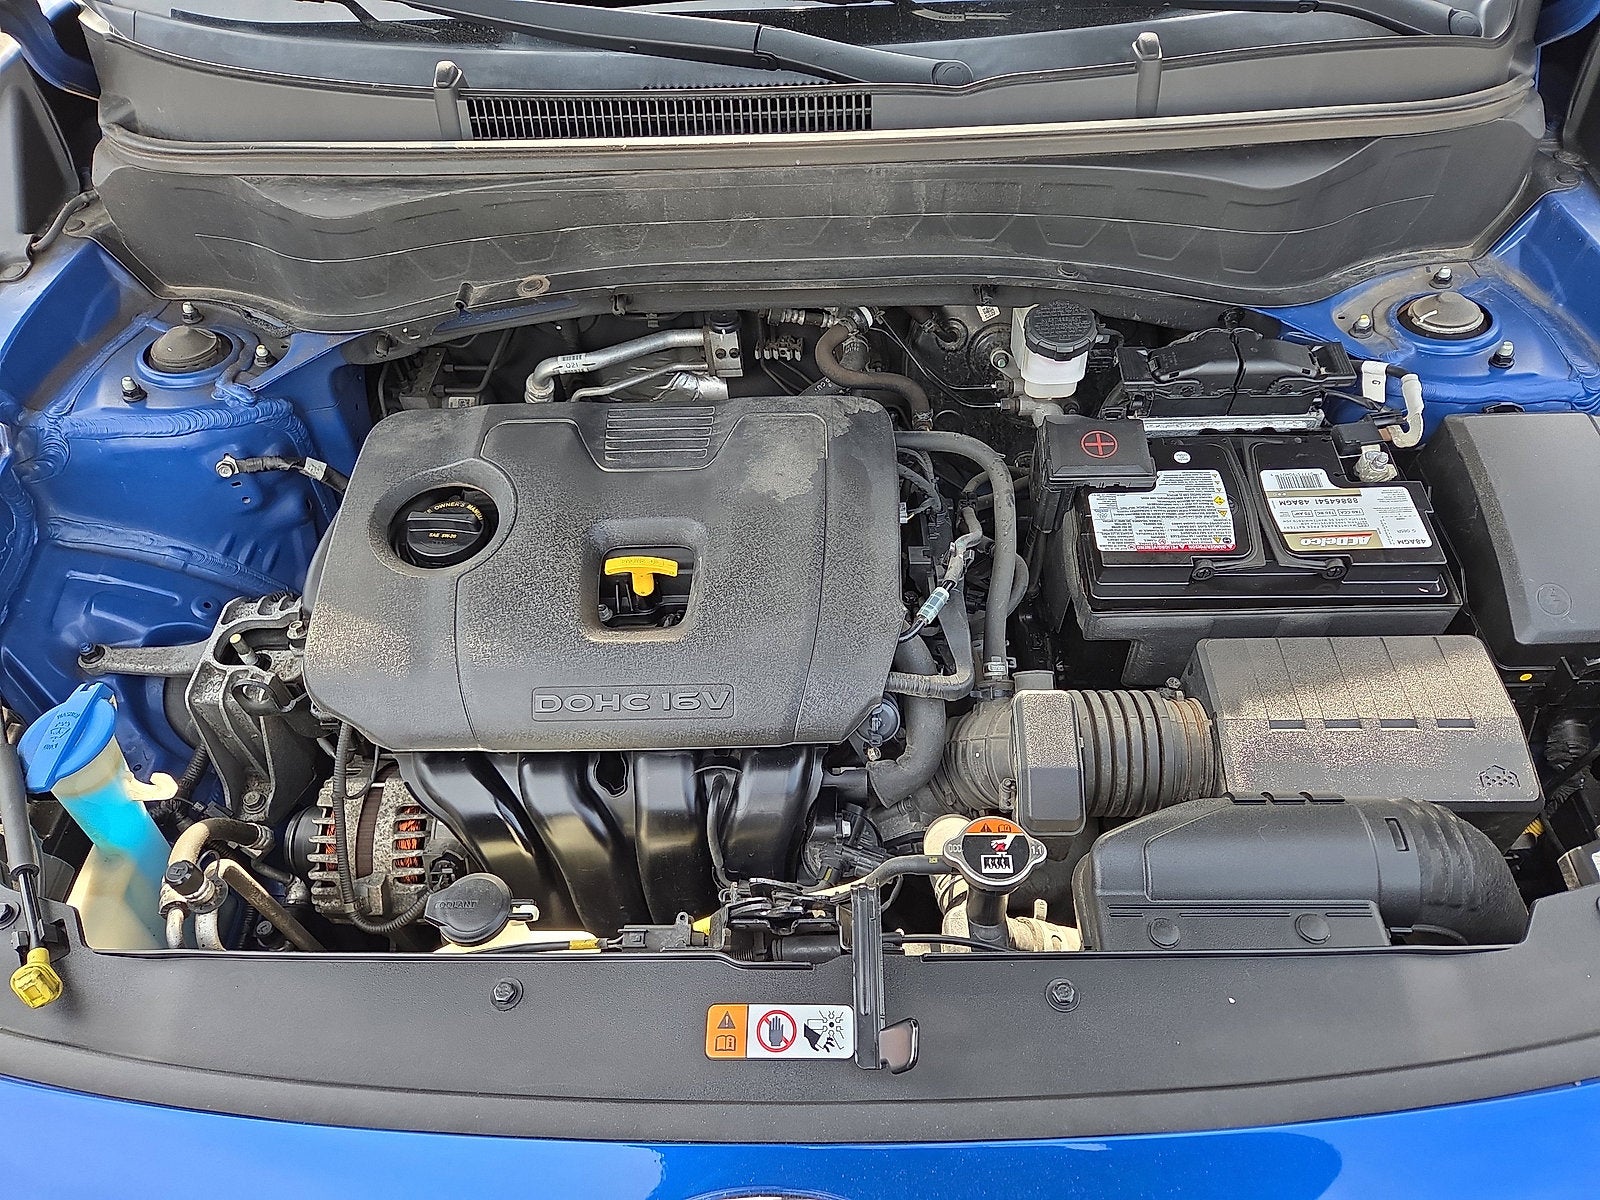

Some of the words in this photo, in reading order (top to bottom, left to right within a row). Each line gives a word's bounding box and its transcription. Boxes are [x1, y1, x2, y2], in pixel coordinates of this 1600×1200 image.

[1300, 536, 1371, 547] ACDelco
[534, 692, 651, 714] DOHC
[661, 690, 732, 712] 16V
[1031, 845, 1044, 855] 1.1
